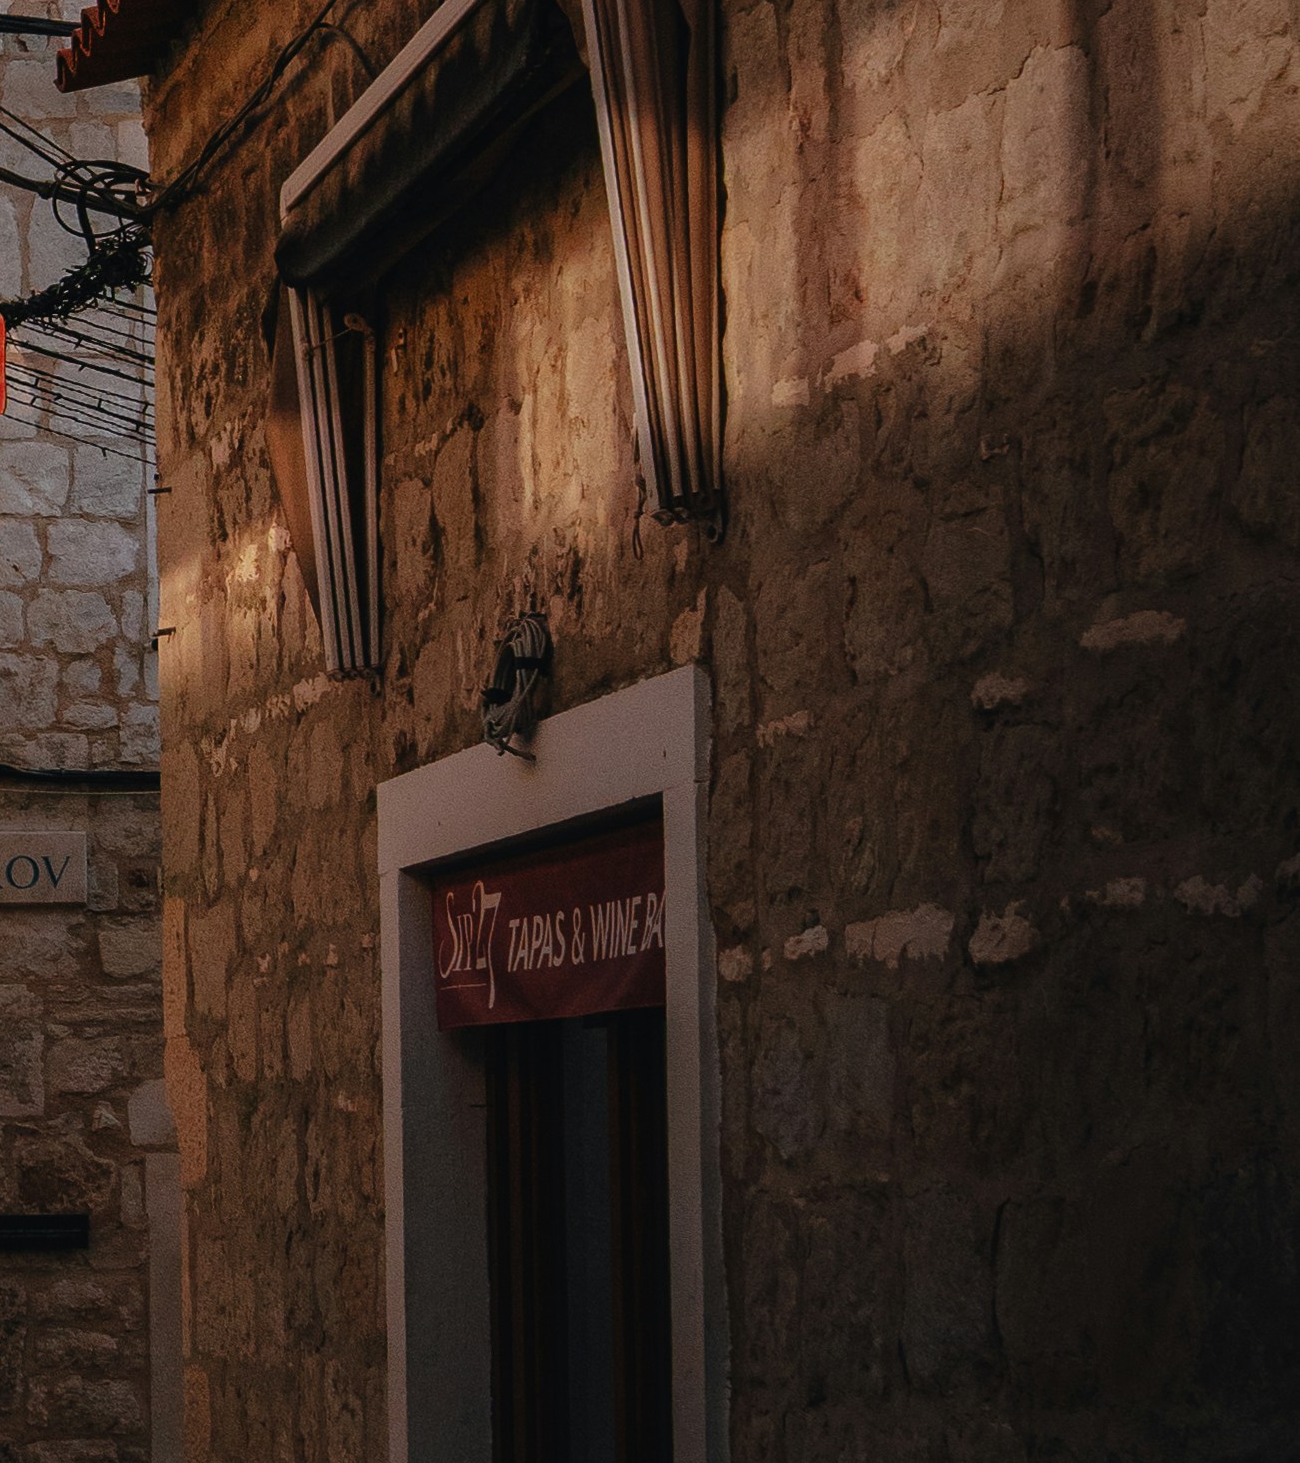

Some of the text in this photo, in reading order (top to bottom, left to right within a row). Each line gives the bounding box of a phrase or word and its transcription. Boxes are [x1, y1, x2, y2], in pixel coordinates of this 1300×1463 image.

[508, 911, 565, 972] TAPAS
[572, 907, 586, 964] &
[590, 895, 641, 960] WINE
[643, 891, 665, 950] BA
